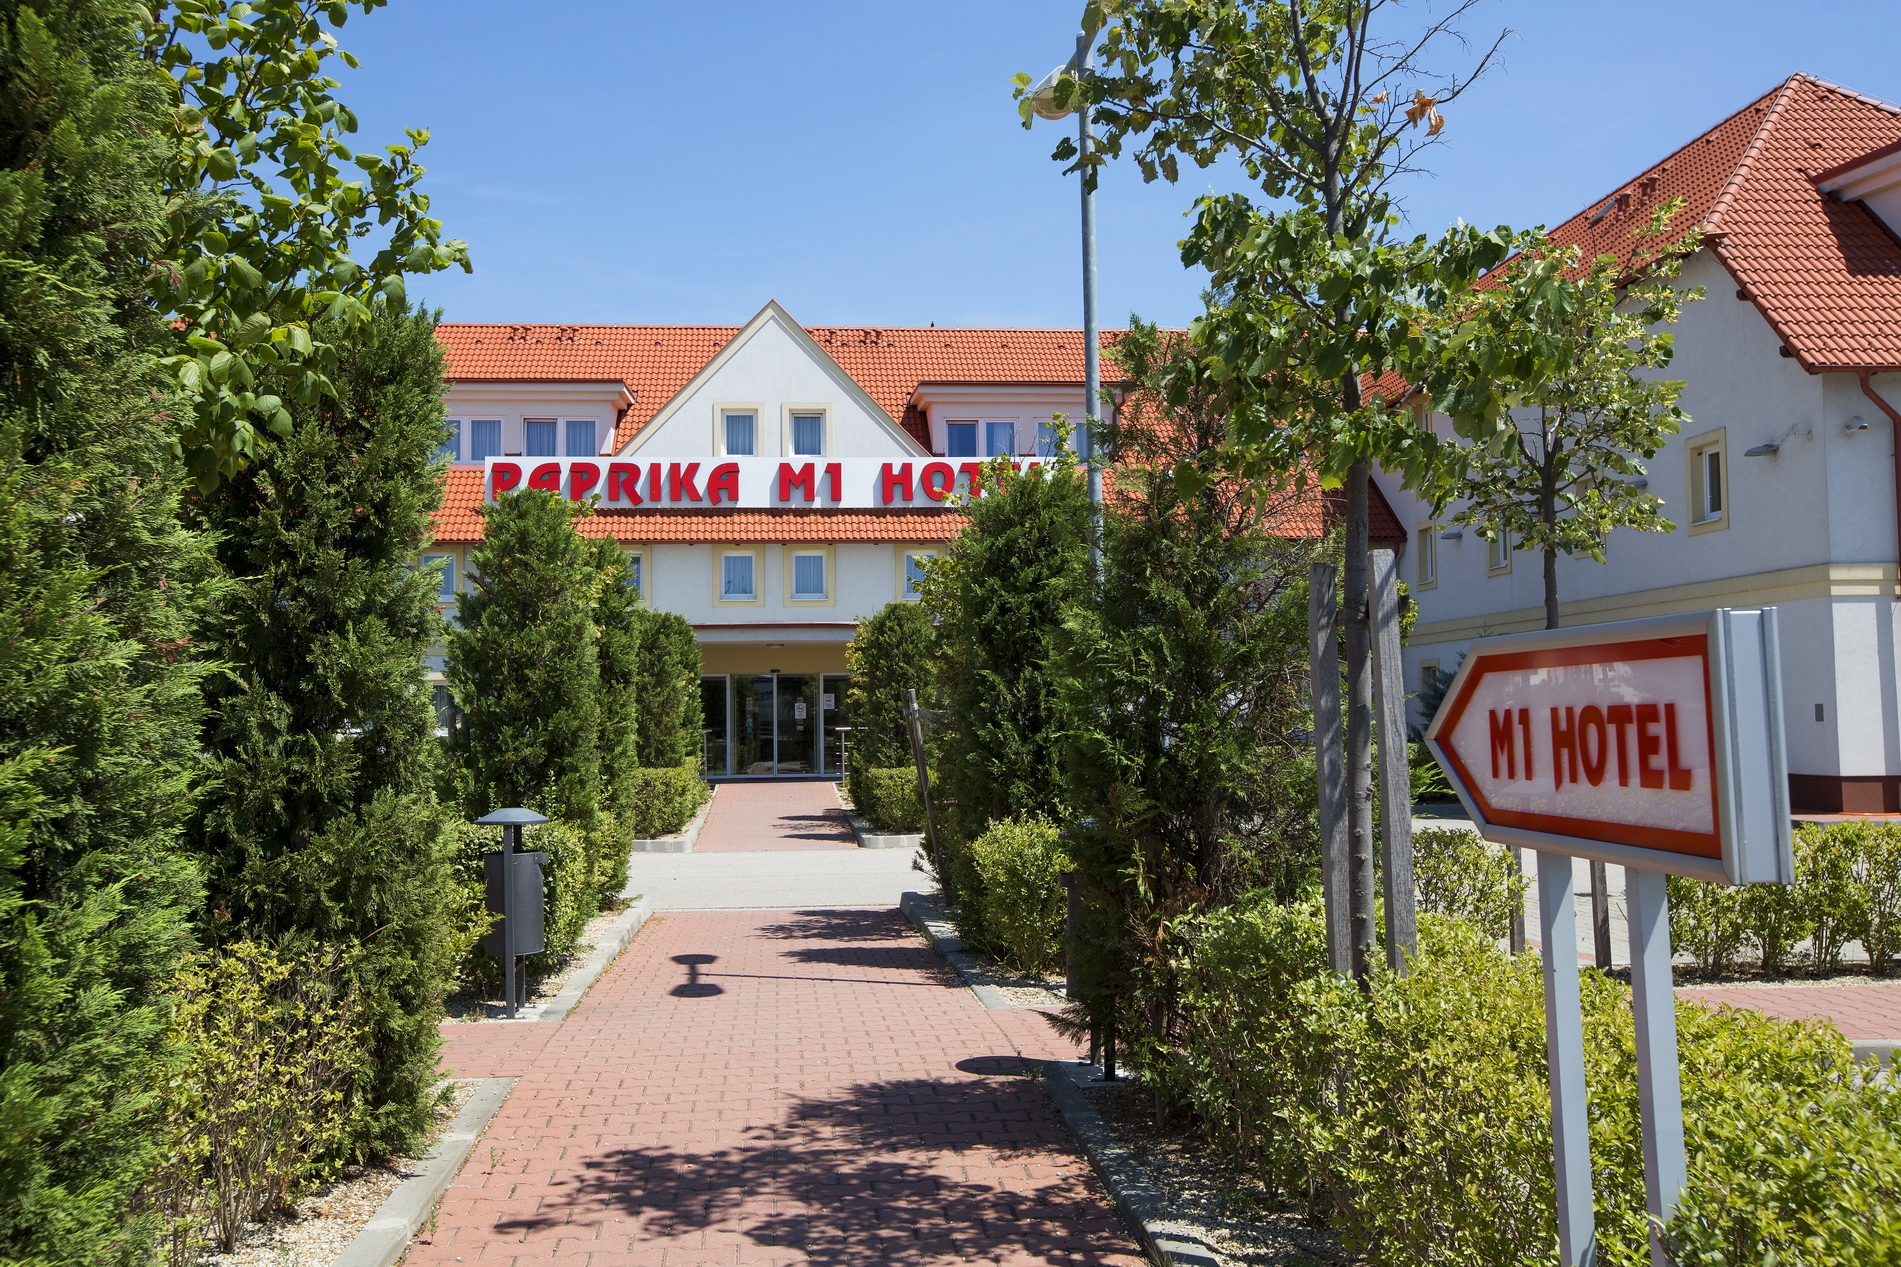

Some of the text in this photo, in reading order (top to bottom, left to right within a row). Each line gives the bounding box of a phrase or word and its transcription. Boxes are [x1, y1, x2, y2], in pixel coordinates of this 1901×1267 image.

[491, 461, 1042, 506] PAPRIKA M1 HOT
[1488, 702, 1692, 793] M1 HOTEL
